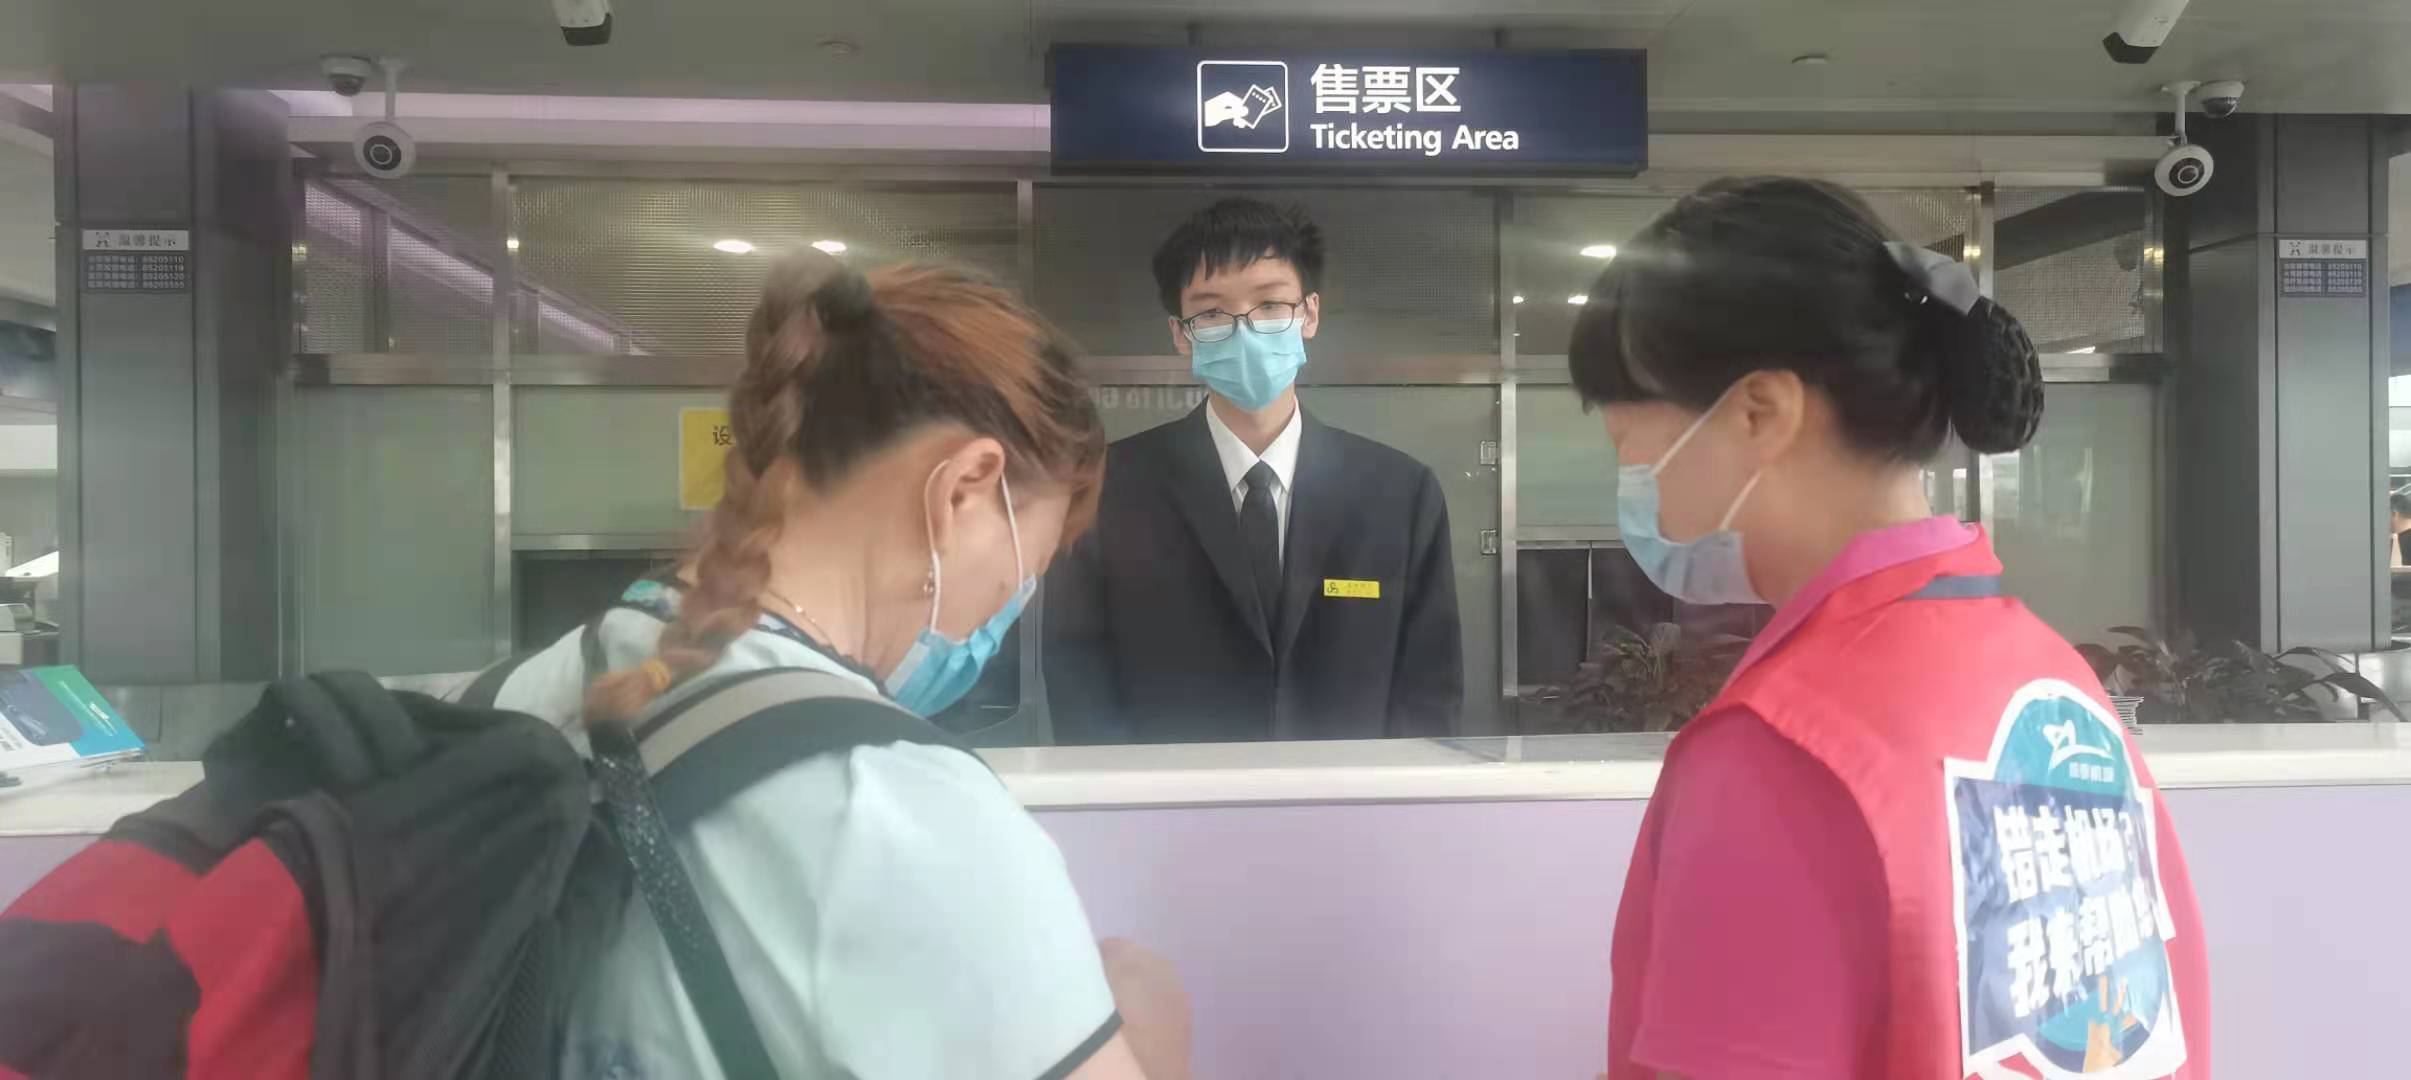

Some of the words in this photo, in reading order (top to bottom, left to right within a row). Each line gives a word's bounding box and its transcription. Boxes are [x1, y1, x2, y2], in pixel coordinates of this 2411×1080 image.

[1310, 64, 1462, 113] 售票区
[1310, 122, 1441, 156] Ticketing
[1451, 124, 1520, 150] Area
